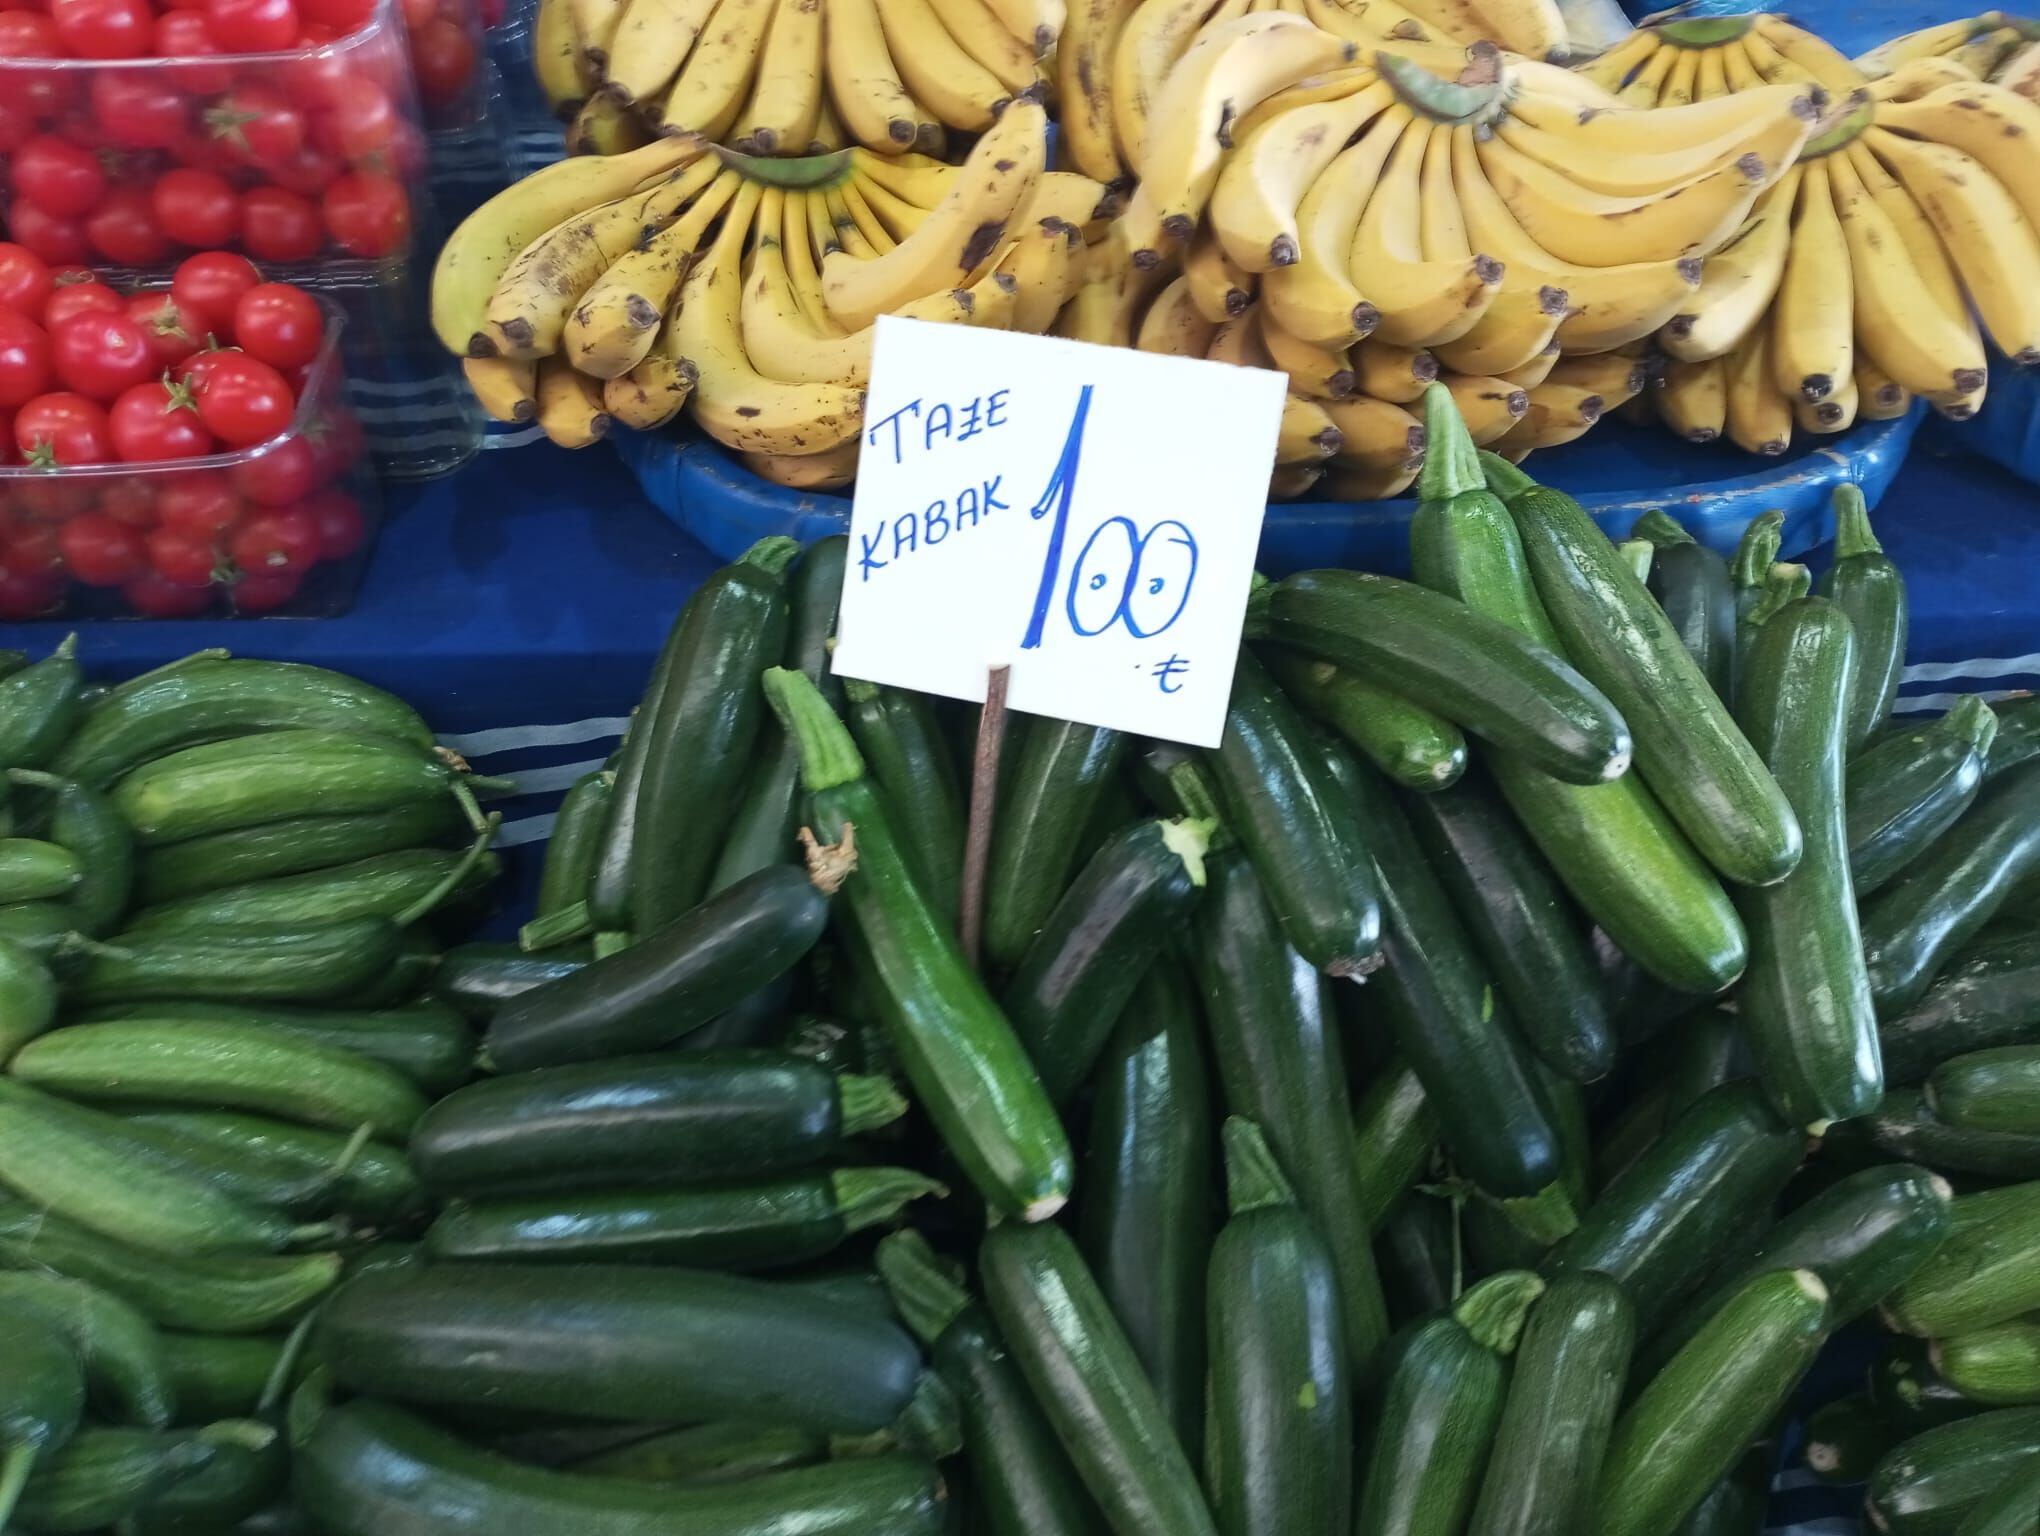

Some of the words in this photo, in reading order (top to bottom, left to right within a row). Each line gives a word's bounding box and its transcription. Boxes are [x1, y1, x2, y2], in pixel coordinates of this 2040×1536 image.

[869, 389, 1010, 464] TAZE
[858, 475, 1009, 582] KABAK
[1020, 384, 1199, 650] 100
